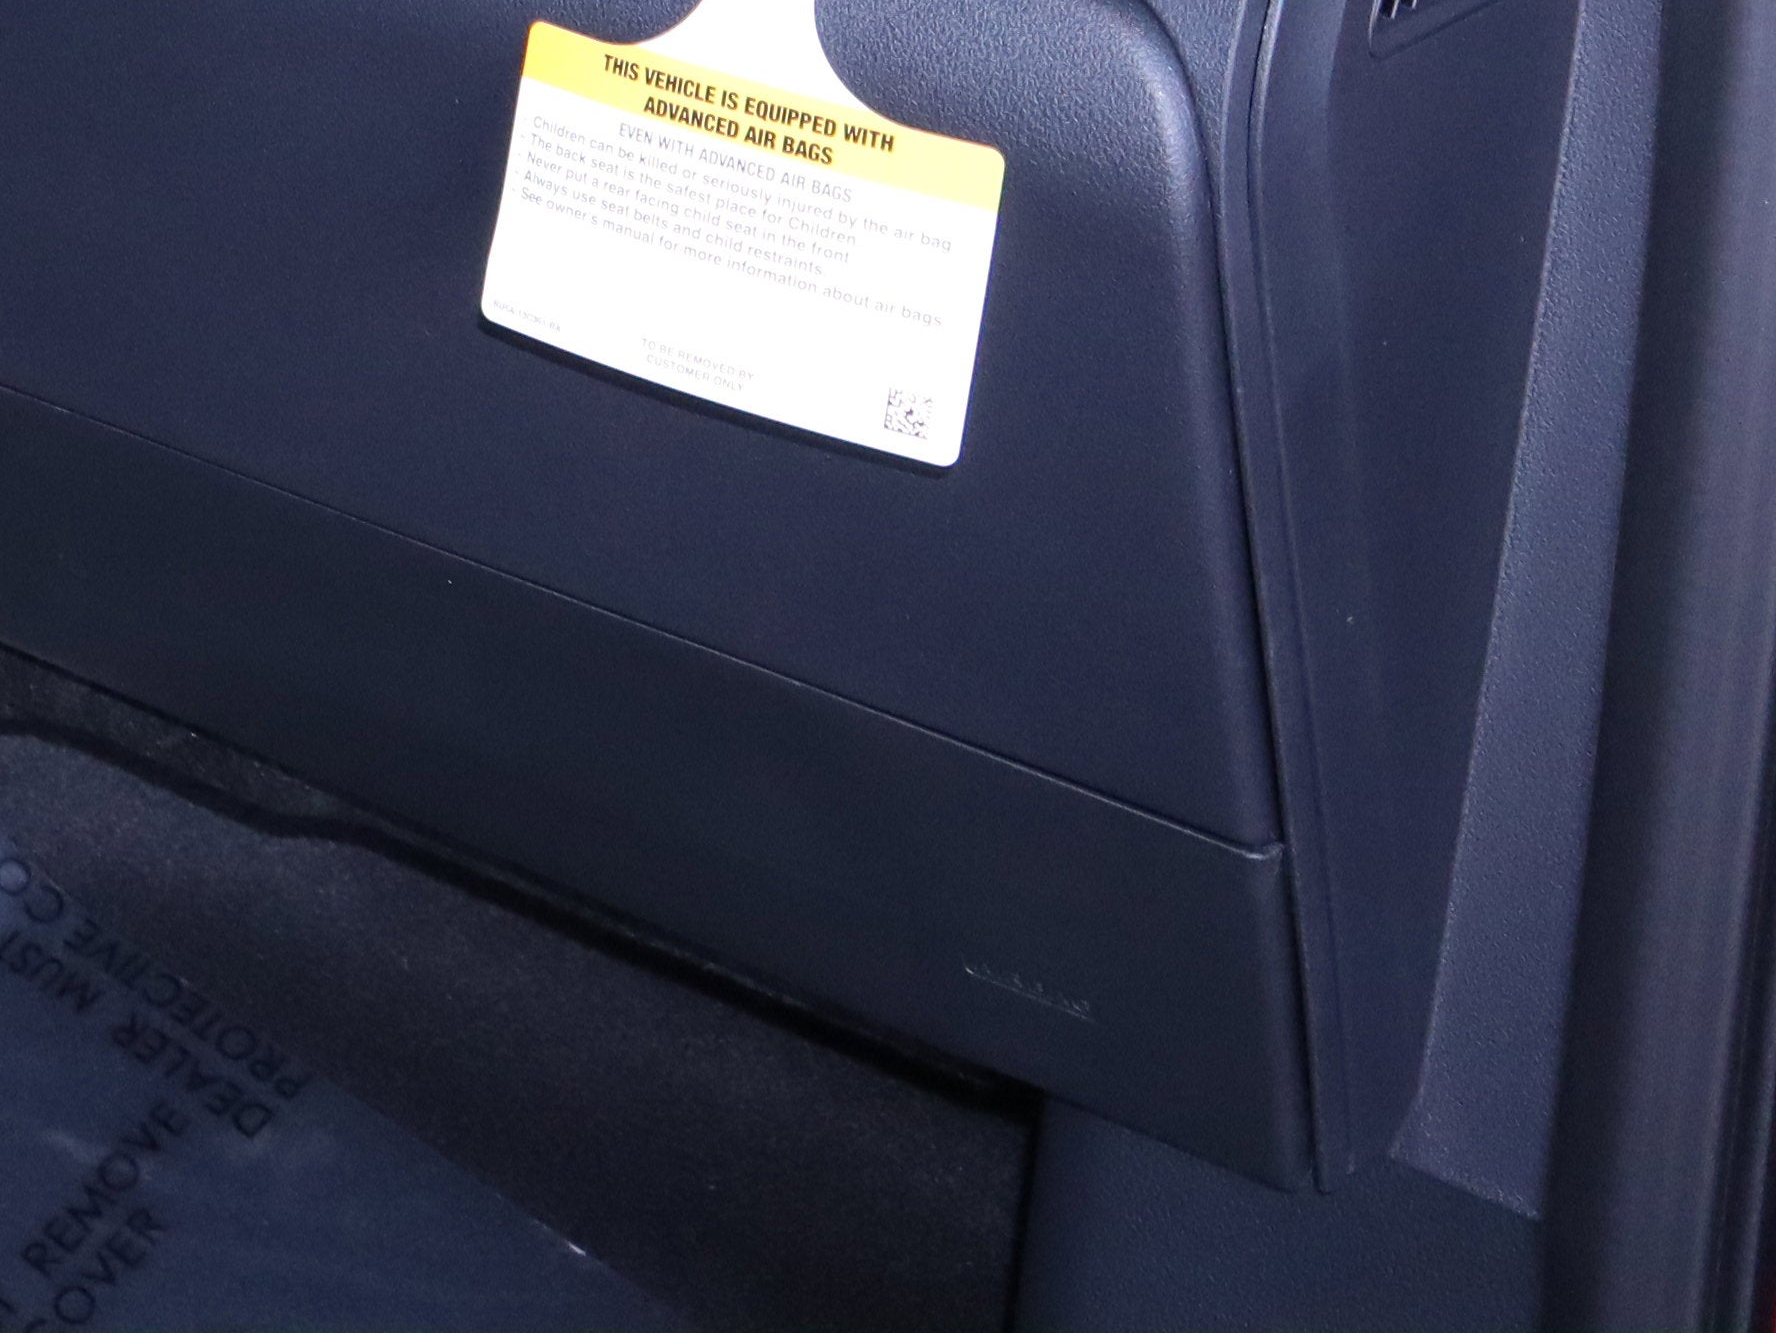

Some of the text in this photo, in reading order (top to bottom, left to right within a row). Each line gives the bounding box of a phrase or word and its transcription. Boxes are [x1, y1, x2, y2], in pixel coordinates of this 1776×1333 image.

[603, 54, 895, 152] THIS VEHICLE IS EQUIPPED WITH
[643, 96, 834, 166] ADVANCED AIR BAGS
[526, 151, 850, 264] Never put a rear facing child seat in the front
[531, 133, 857, 245] The back seat is the safest place for Children
[532, 115, 952, 253] Children can be killed or seriously injured by the air bag
[619, 123, 853, 203] EVEN WITH ADVANCED AIR BAGS
[521, 188, 542, 206] See
[603, 217, 656, 245] manual
[658, 234, 679, 253] for
[682, 241, 722, 266] more
[727, 255, 817, 294] information
[822, 285, 870, 308] about
[874, 299, 895, 313] air
[901, 305, 943, 327] bags
[523, 169, 824, 275] Always use seat belts and child restraints
[641, 338, 657, 351] TO
[677, 349, 735, 375] REMOVED
[646, 353, 744, 393] CUSTOMER ONLY
[63, 918, 315, 1100] PROTECTIVE
[111, 1013, 274, 1139] DEALER
[20, 1100, 191, 1278] REMOVE
